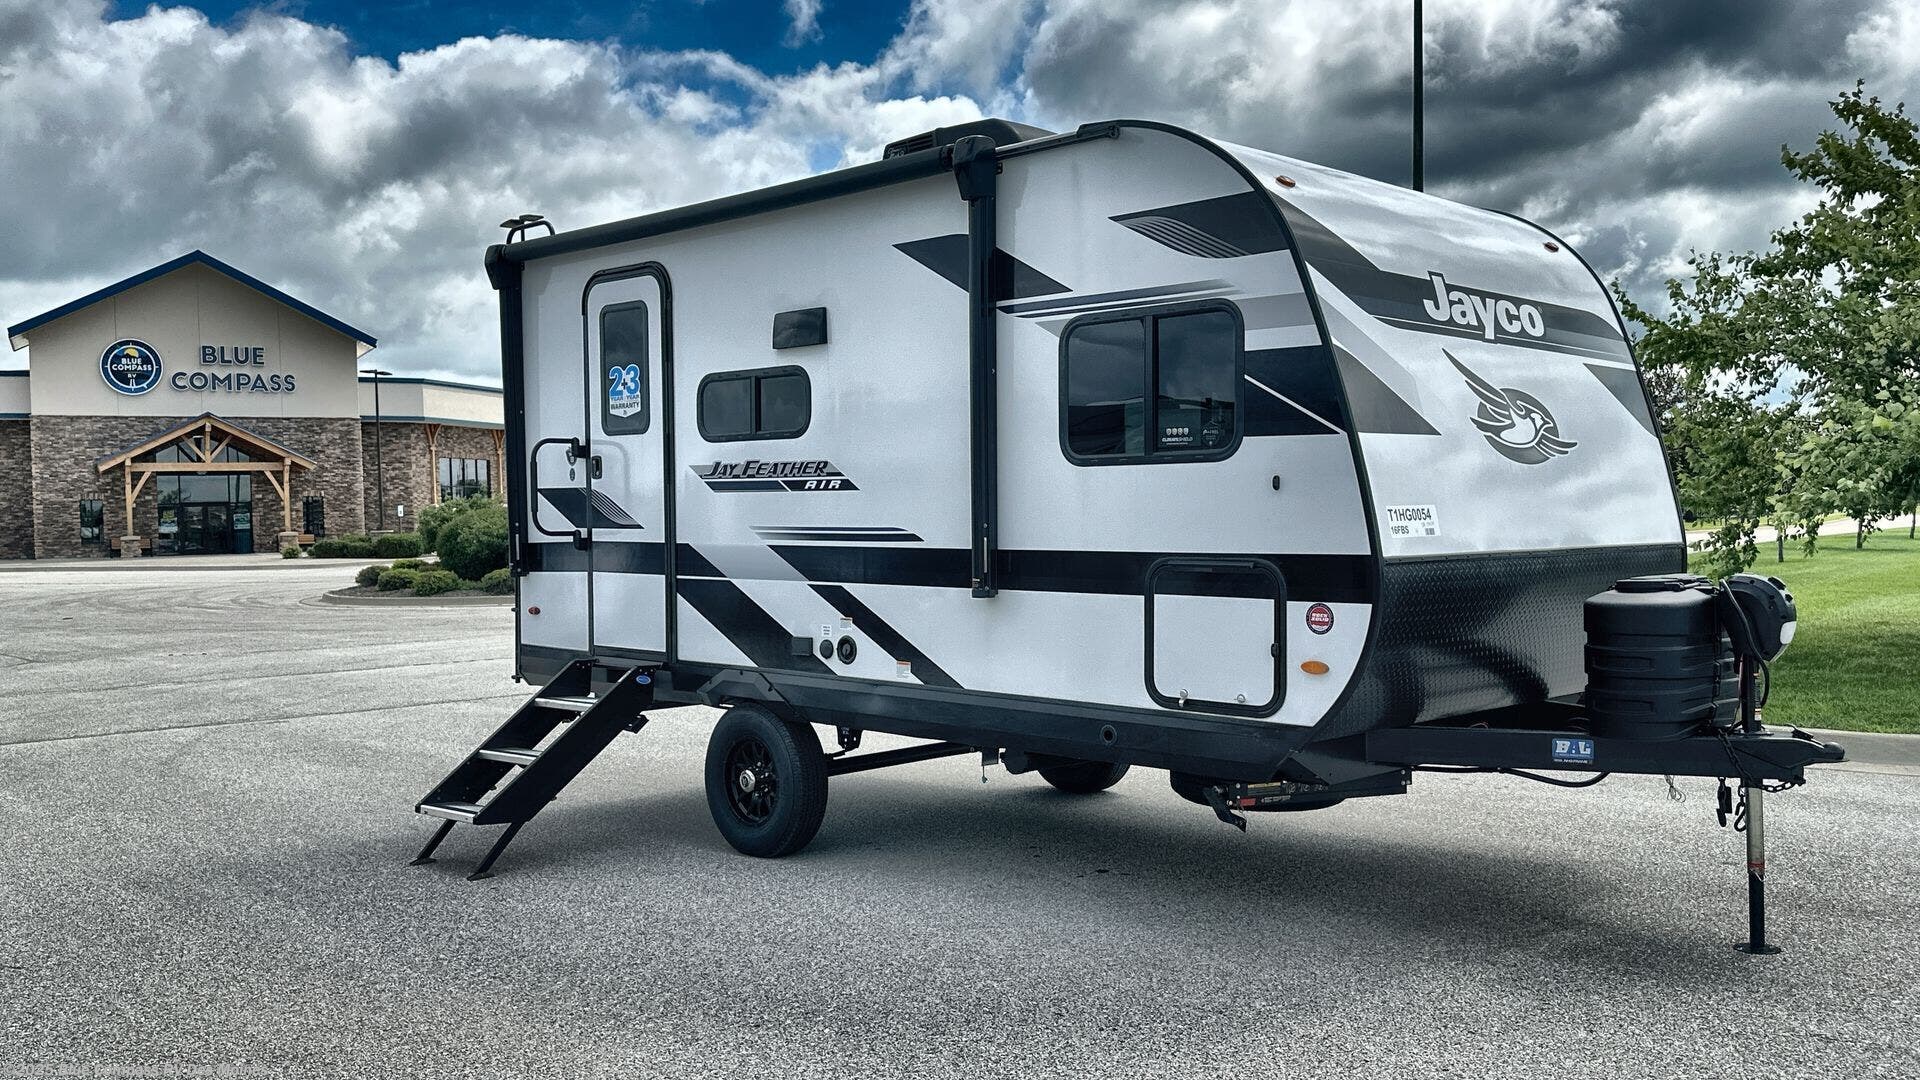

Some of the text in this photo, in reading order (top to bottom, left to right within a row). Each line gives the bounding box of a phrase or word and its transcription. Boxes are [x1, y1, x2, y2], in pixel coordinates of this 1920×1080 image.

[1422, 271, 1545, 341] Jayco
[121, 357, 142, 365] BLUE
[200, 345, 266, 366] BLUE
[111, 364, 153, 372] COMPASS
[170, 371, 296, 393] COMPASS
[610, 402, 640, 410] WARRANTY
[703, 459, 829, 478] JAY FEATHER
[804, 480, 842, 490] AIR
[1387, 508, 1432, 522] T1HG0054
[1390, 525, 1410, 535] 16FBS
